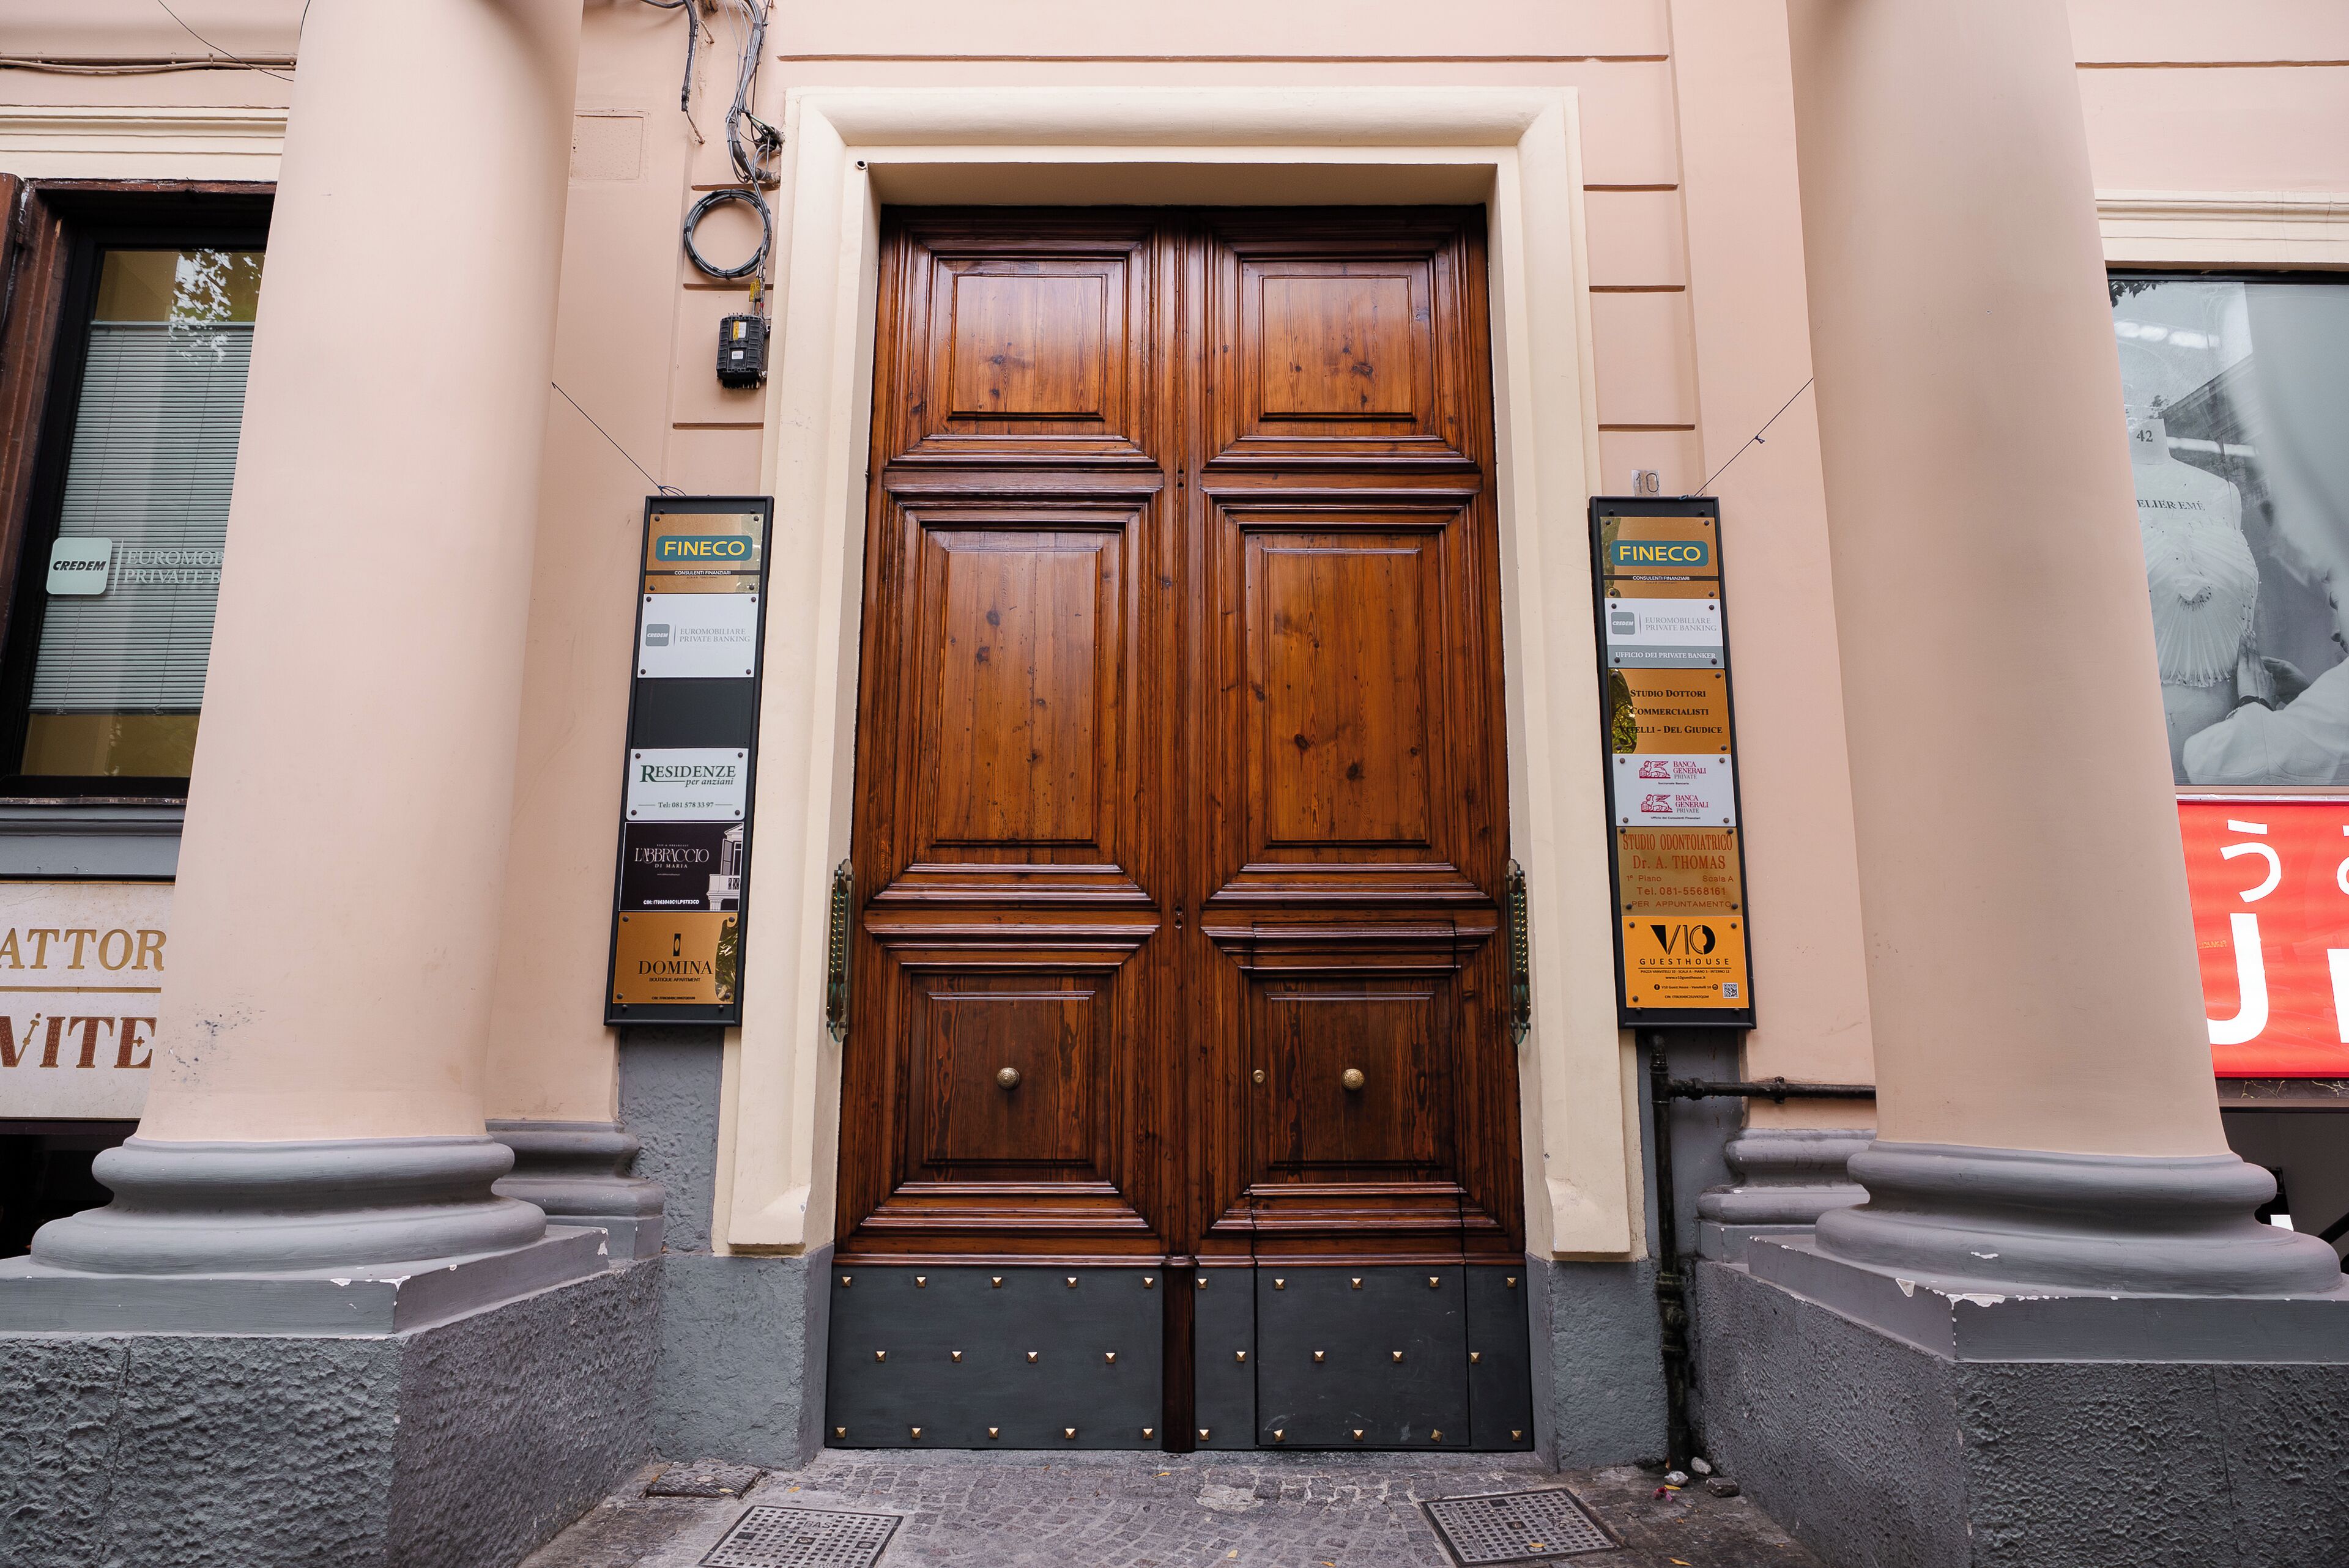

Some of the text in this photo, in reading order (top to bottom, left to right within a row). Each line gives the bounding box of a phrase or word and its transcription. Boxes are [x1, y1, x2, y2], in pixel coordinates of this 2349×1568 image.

[2136, 429, 2153, 442] 42
[664, 541, 745, 556] FINECO
[1620, 545, 1701, 561] FINECO
[53, 560, 106, 571] CREDEM
[122, 569, 204, 583] PRIVATE
[639, 765, 736, 783] RESIDENZE
[685, 778, 700, 788] per
[1623, 834, 1732, 851] STUDIO ODONTOIATRICO
[1633, 856, 1725, 869] Dr. A. THOMAS
[1636, 887, 1726, 895] Tel. 081-5568161
[0, 928, 166, 971] ATTOR
[638, 960, 714, 975] DOMINA
